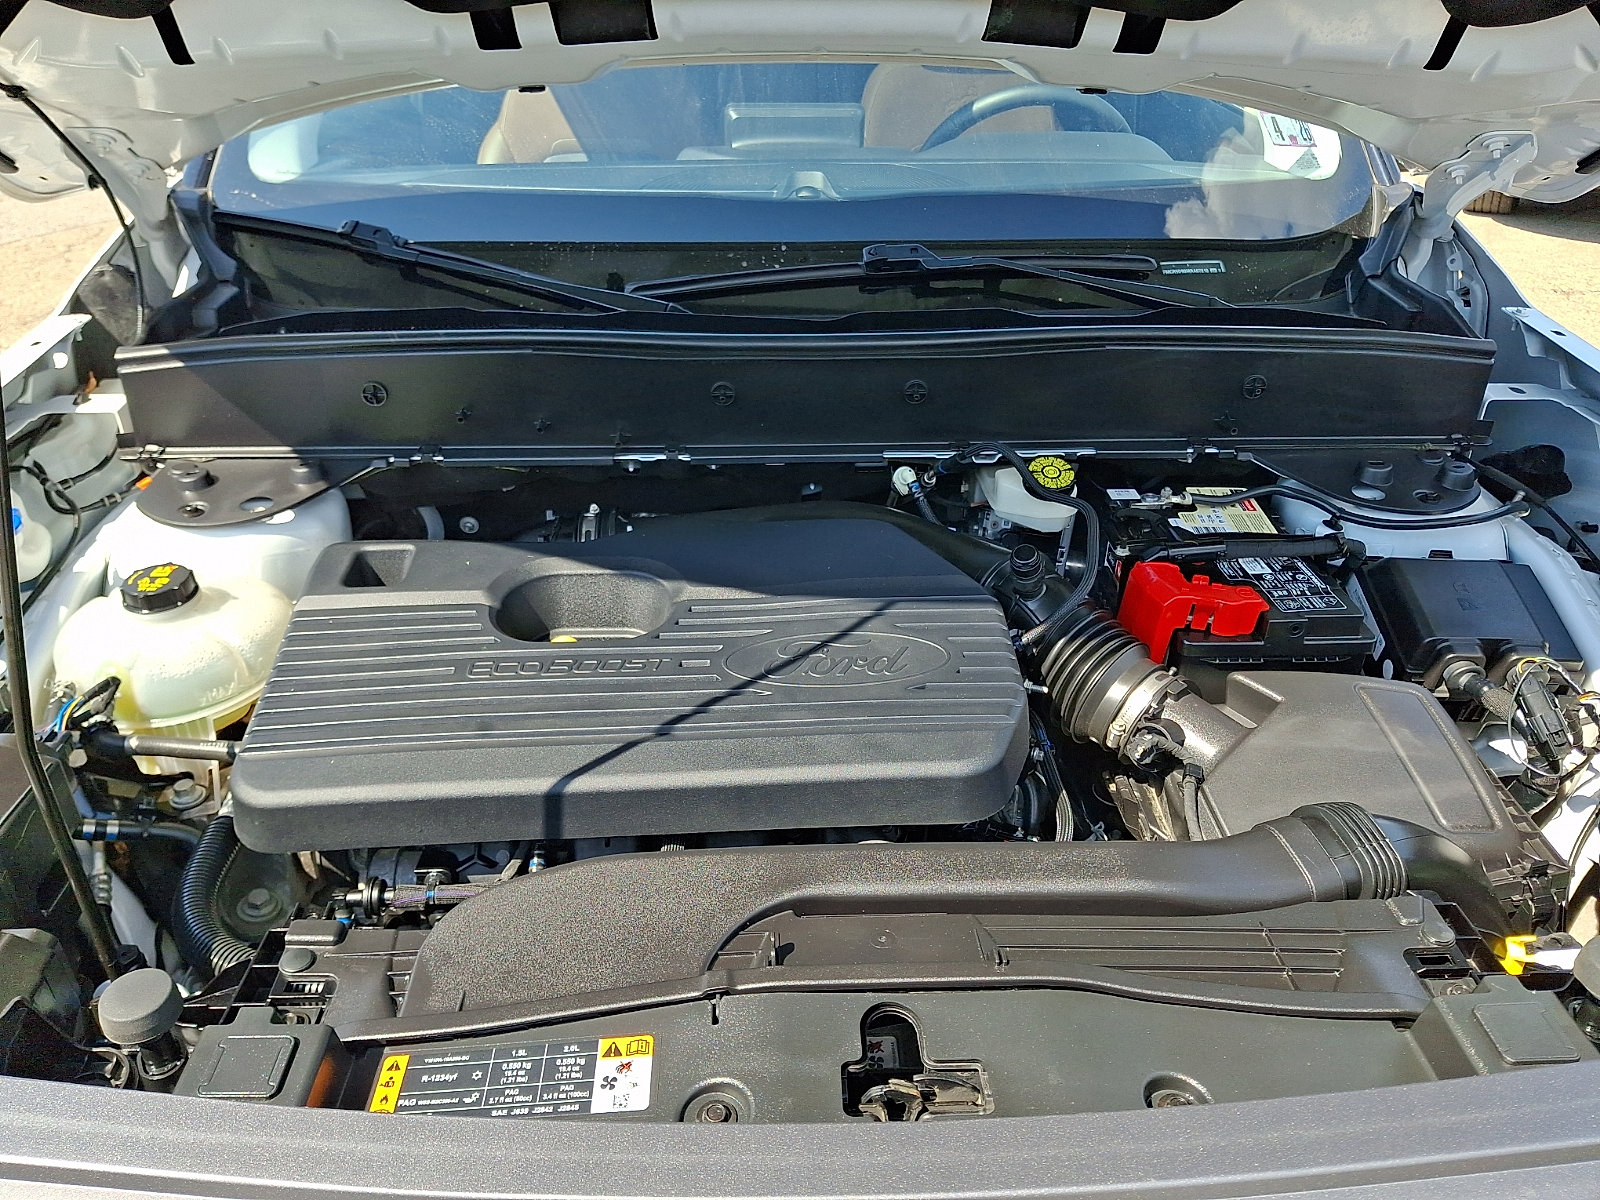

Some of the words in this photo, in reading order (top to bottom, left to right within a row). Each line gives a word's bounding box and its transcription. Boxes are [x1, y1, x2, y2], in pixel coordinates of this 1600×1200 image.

[1271, 116, 1285, 141] 4
[762, 639, 910, 678] Ford
[511, 1049, 527, 1057] 1.5L
[563, 1045, 580, 1053] 2.0L
[576, 1057, 585, 1065] kg
[522, 1062, 532, 1070] kg
[397, 1099, 416, 1107] PAG
